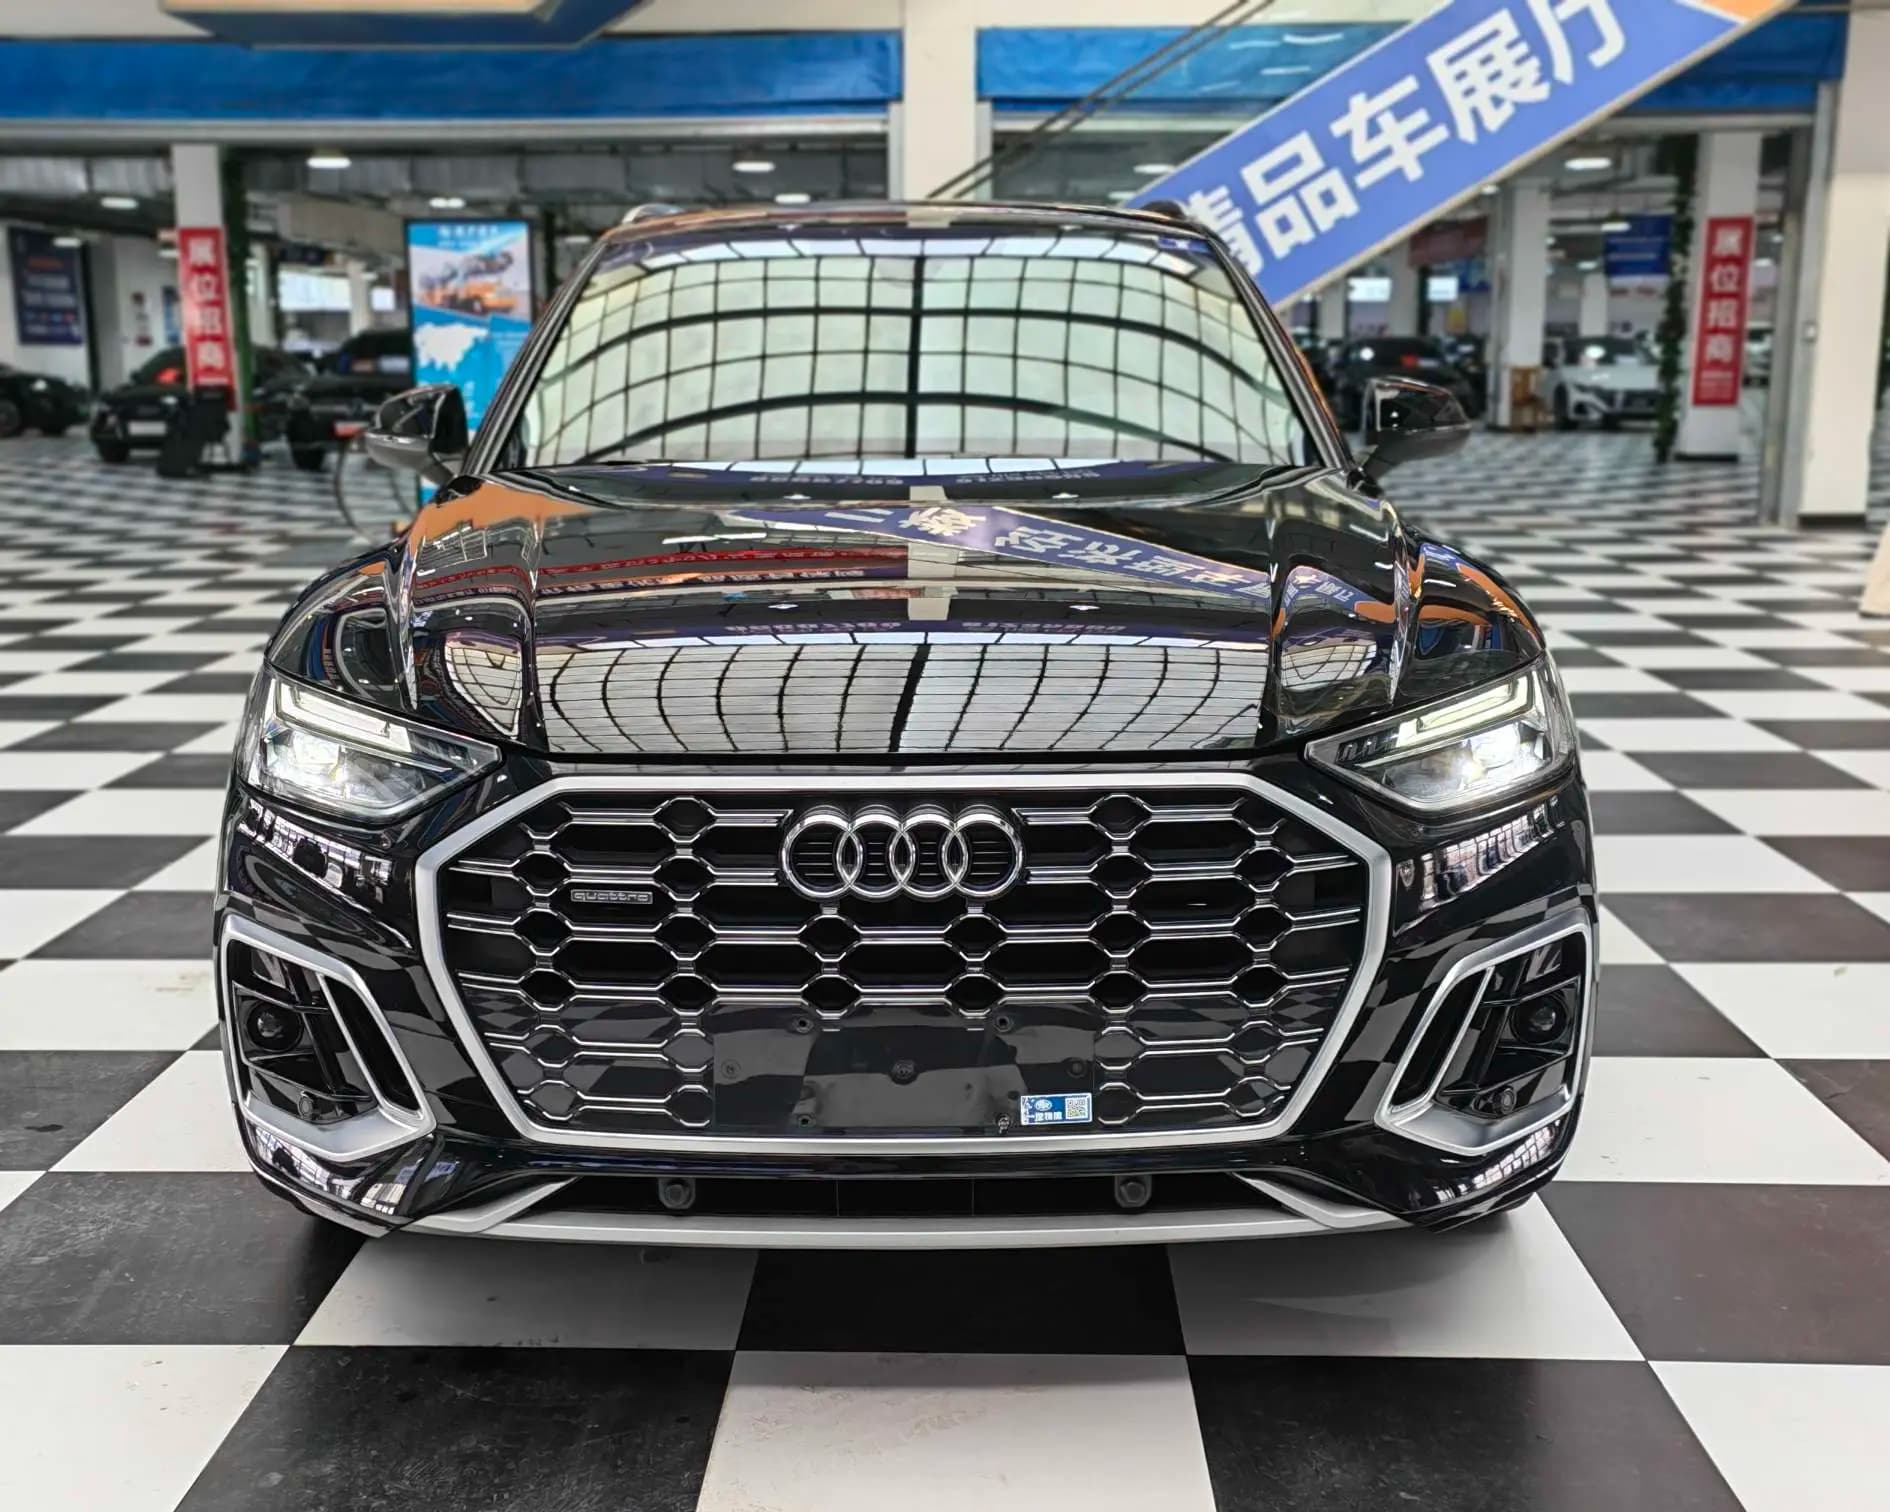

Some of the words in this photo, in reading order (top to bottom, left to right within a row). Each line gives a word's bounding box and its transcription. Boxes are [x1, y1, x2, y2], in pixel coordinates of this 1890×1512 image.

[1705, 226, 1744, 364] 展位招商
[574, 891, 649, 902] quattro
